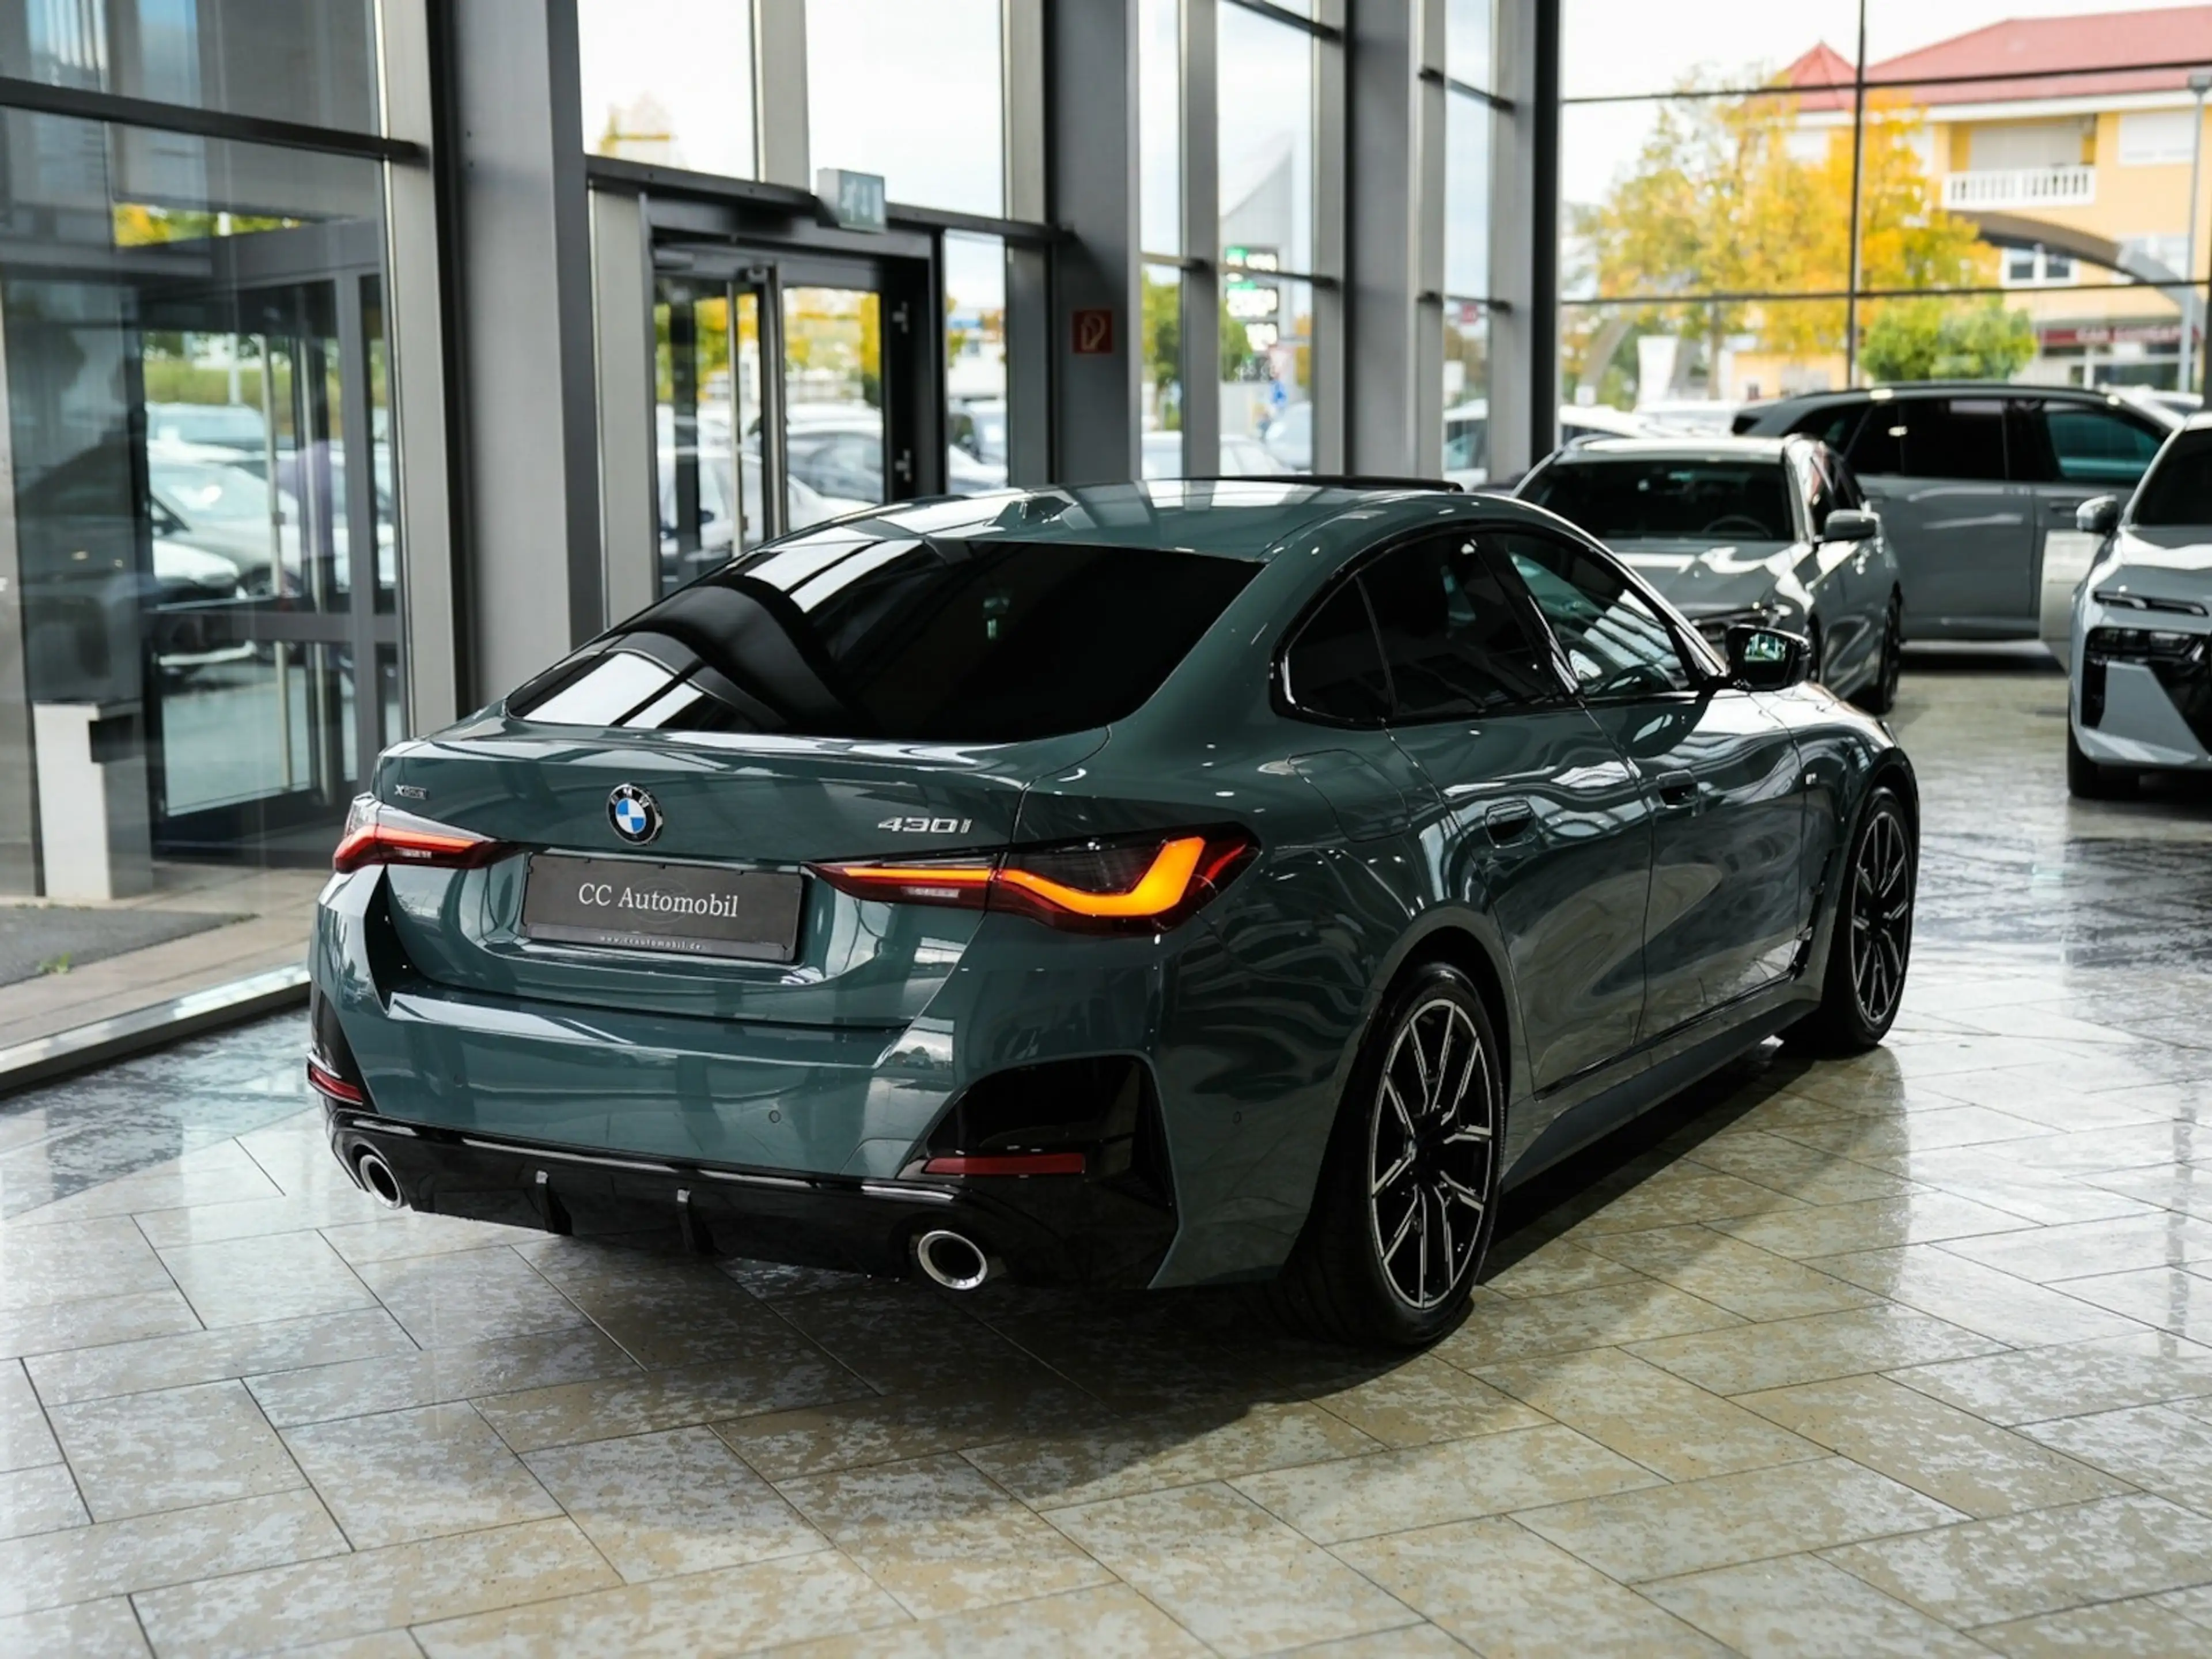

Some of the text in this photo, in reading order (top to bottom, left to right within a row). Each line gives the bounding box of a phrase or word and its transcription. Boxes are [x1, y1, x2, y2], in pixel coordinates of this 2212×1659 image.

[877, 817, 972, 834] 430i
[578, 882, 738, 918] CC Automobil
